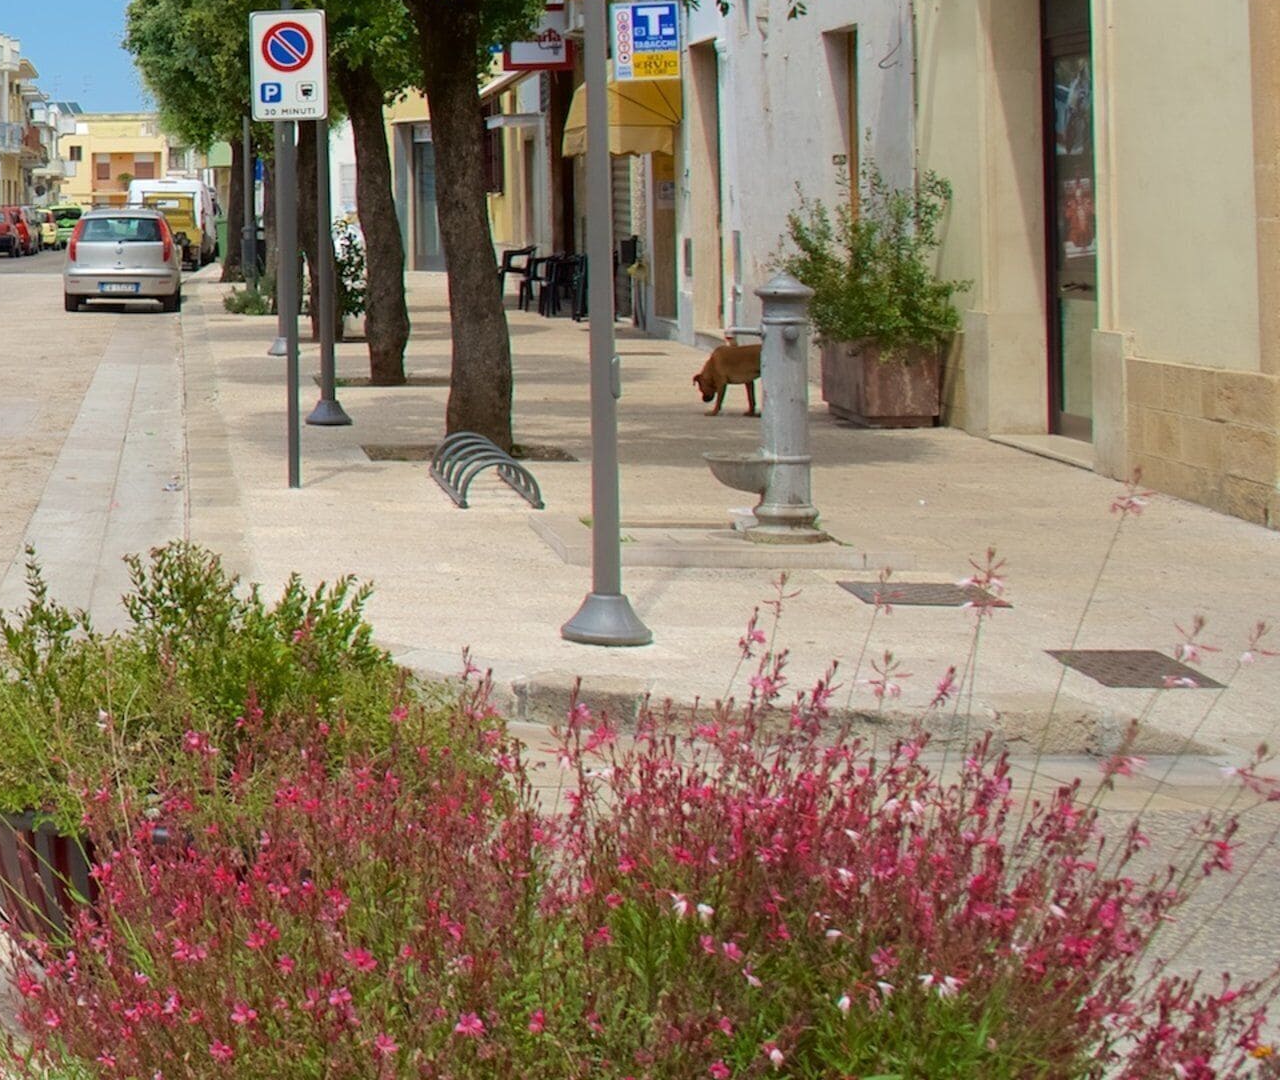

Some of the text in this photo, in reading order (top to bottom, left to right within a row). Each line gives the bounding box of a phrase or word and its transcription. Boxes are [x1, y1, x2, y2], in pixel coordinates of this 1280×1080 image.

[637, 7, 669, 36] T
[634, 40, 677, 49] TABACCHI
[265, 85, 279, 101] P
[281, 107, 316, 116] MINUTI
